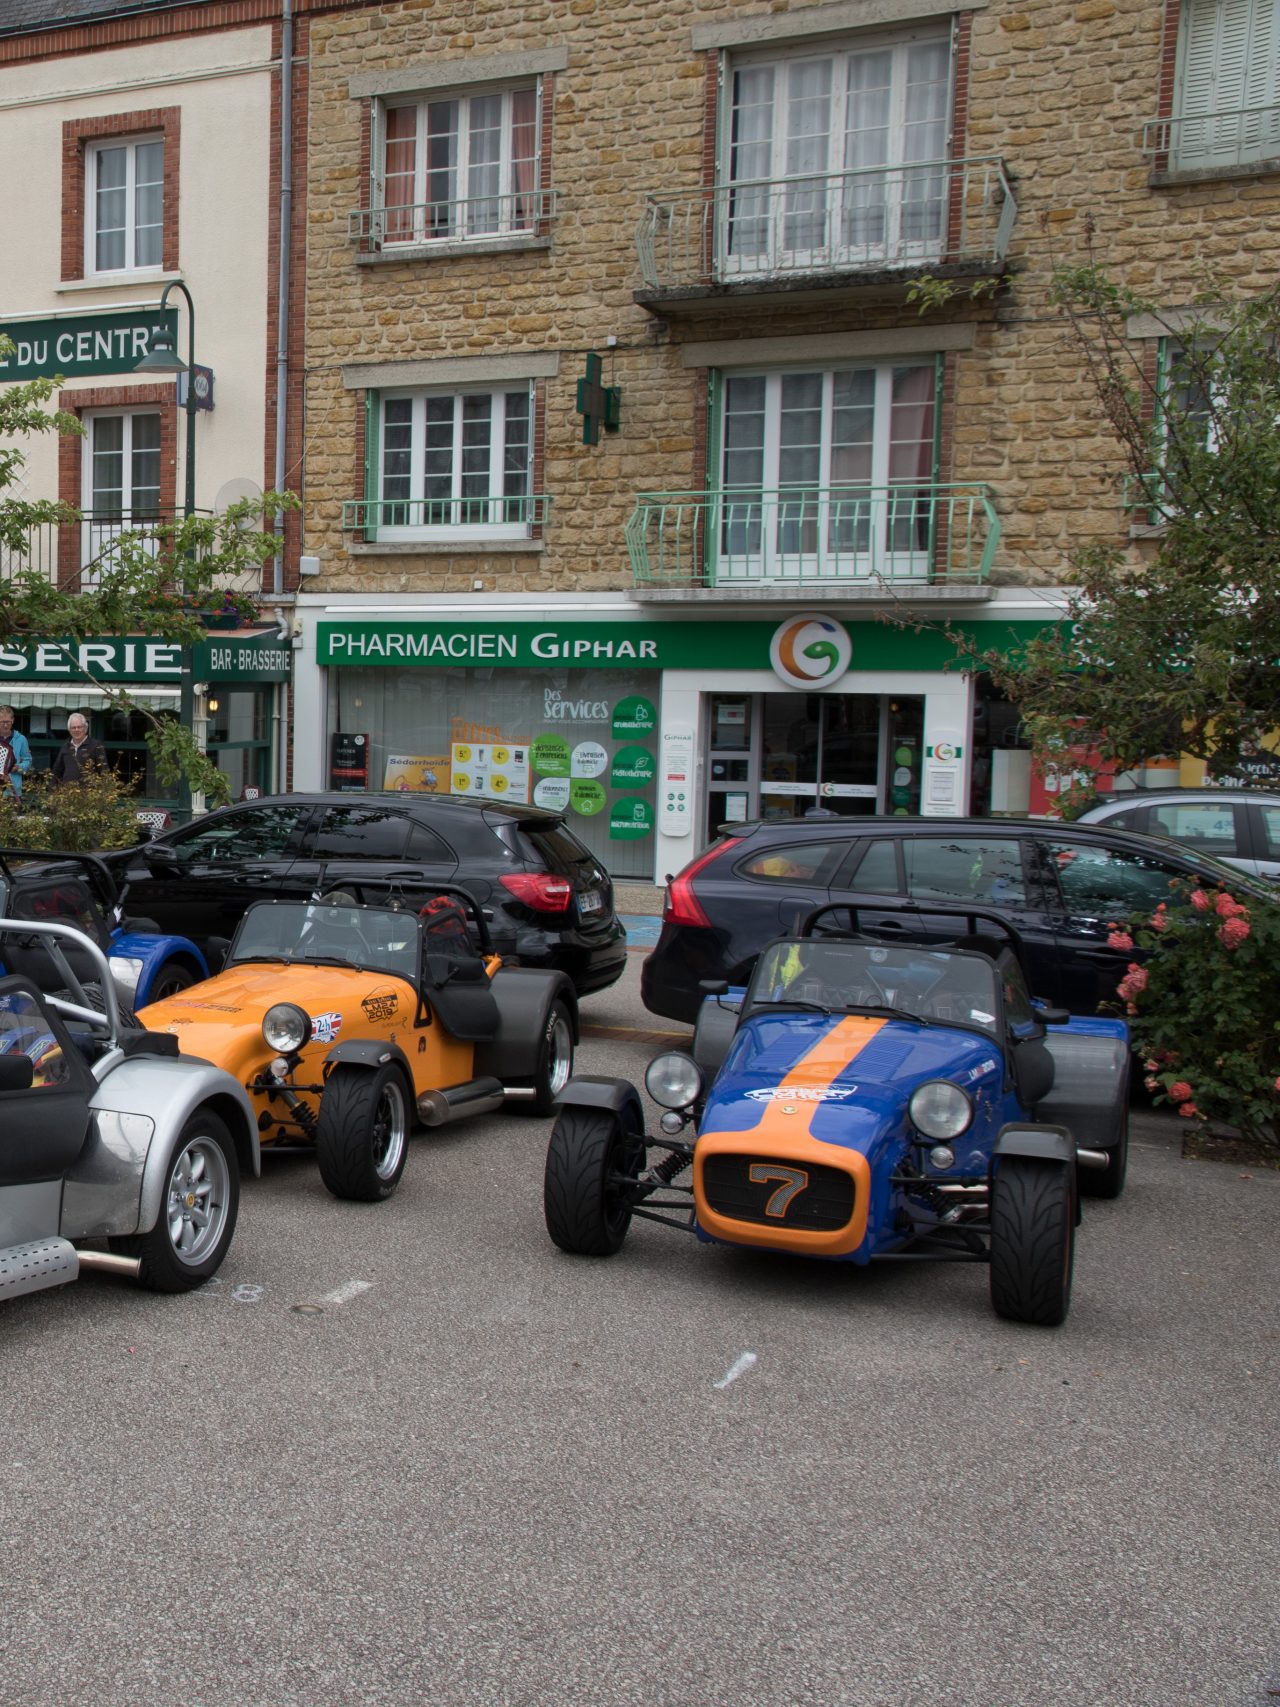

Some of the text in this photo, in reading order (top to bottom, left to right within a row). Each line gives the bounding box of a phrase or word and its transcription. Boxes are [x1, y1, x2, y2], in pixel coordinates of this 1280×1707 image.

[17, 340, 48, 366] DU
[56, 325, 168, 363] CENTR
[328, 633, 517, 658] PHARMACIEN
[211, 648, 291, 672] BAR BRASSERIE
[544, 687, 562, 701] Des
[543, 699, 609, 719] services
[749, 1163, 809, 1218] 7
